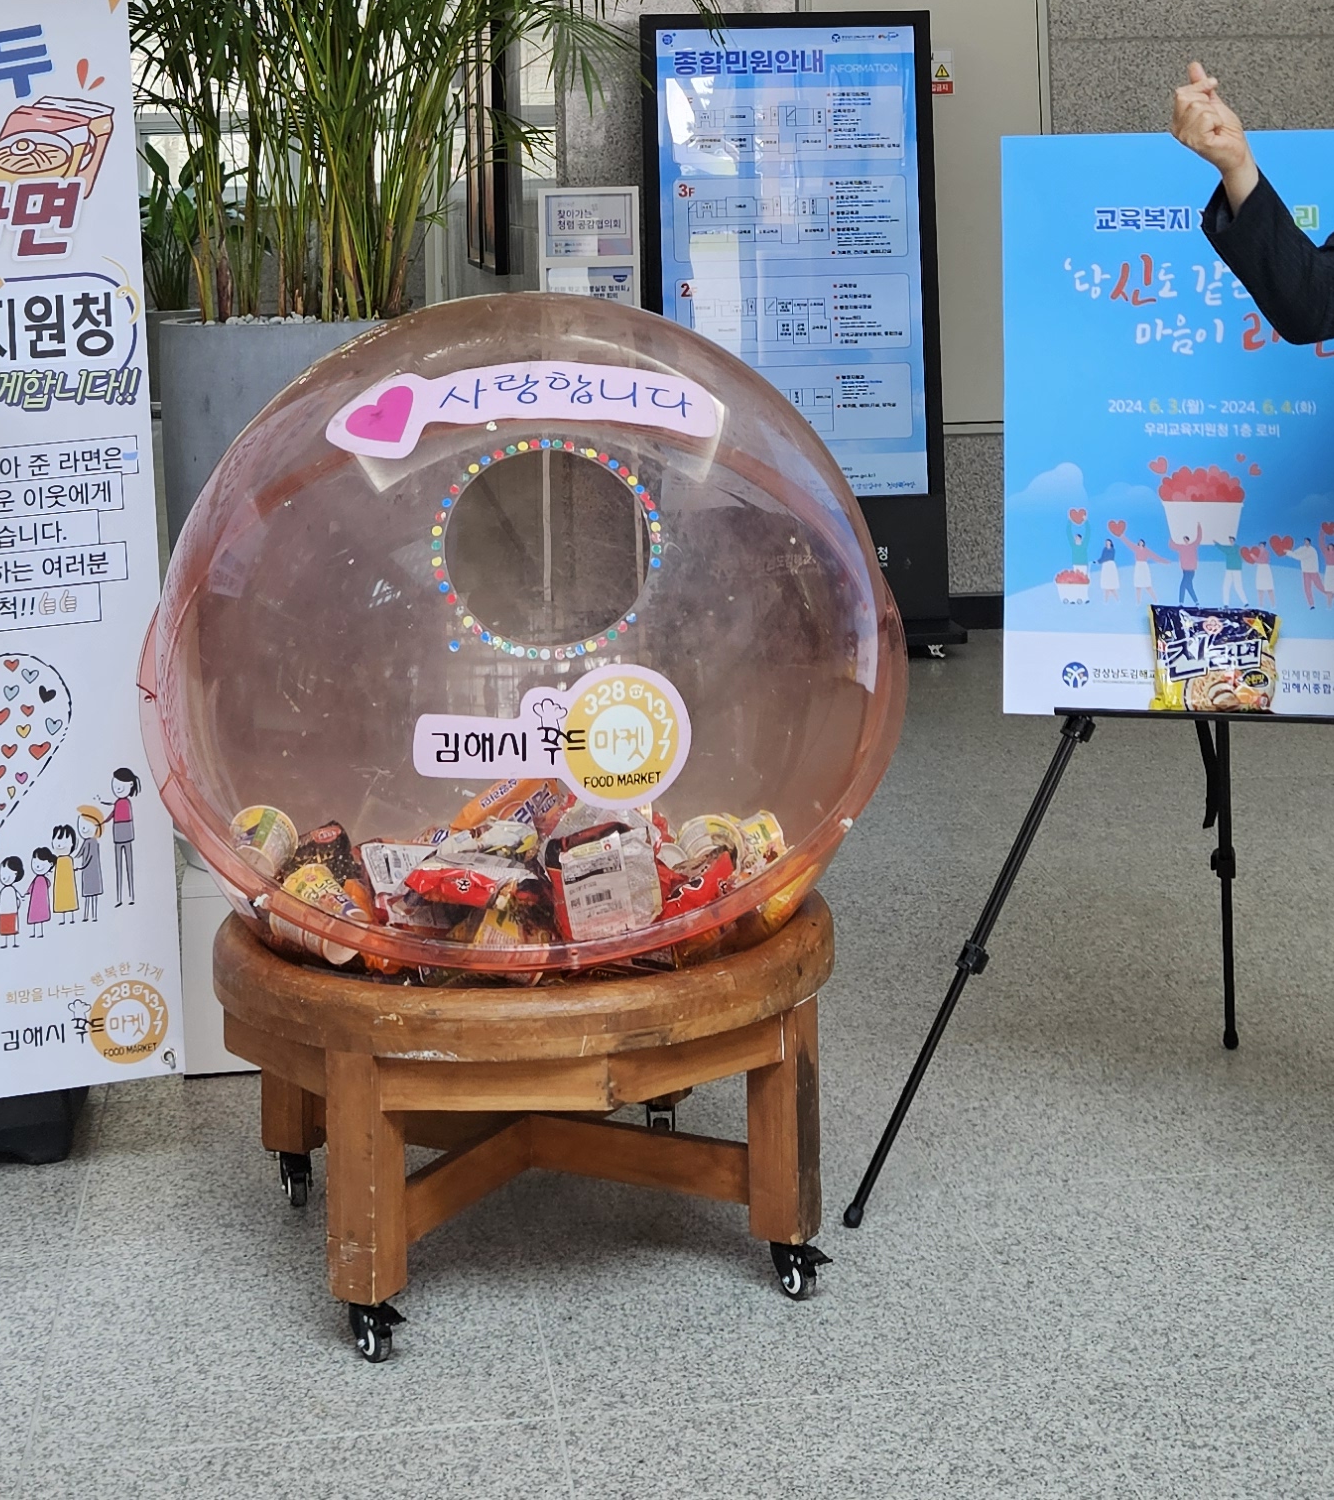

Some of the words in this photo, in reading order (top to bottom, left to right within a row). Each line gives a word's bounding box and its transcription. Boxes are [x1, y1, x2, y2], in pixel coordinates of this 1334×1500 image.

[674, 50, 824, 76] 종합민원안내
[830, 63, 897, 73] INFORMATION
[678, 184, 695, 198] 3F
[557, 209, 593, 219] 찾아가는
[557, 219, 575, 230] 청렴
[577, 219, 622, 230] 공감협의회
[1094, 207, 1192, 231] 교육복지
[1135, 314, 1225, 355] 마음이
[439, 371, 692, 418] 사랑합니다
[1108, 400, 1147, 415] 2024.
[1220, 400, 1257, 415] 2024.
[1144, 423, 1229, 438] 우리교육지원청
[1233, 423, 1253, 437] 1층
[1255, 422, 1281, 438] 로비
[28, 453, 51, 476] 준
[58, 446, 122, 474] 라면은
[23, 481, 111, 509] 이웃에게
[42, 551, 109, 577] 여러분
[584, 681, 626, 716] 328
[643, 692, 674, 761] 1377
[431, 732, 527, 763] 김해시
[583, 776, 614, 789] FOOD
[616, 771, 662, 786] MARKET
[5, 987, 43, 1004] 희망을
[48, 983, 85, 999] 나누는
[90, 961, 131, 987] 행복한
[137, 962, 164, 981] 가게
[101, 983, 130, 1009] 328
[103, 1047, 125, 1057] FOOD
[126, 1042, 157, 1055] MARKET
